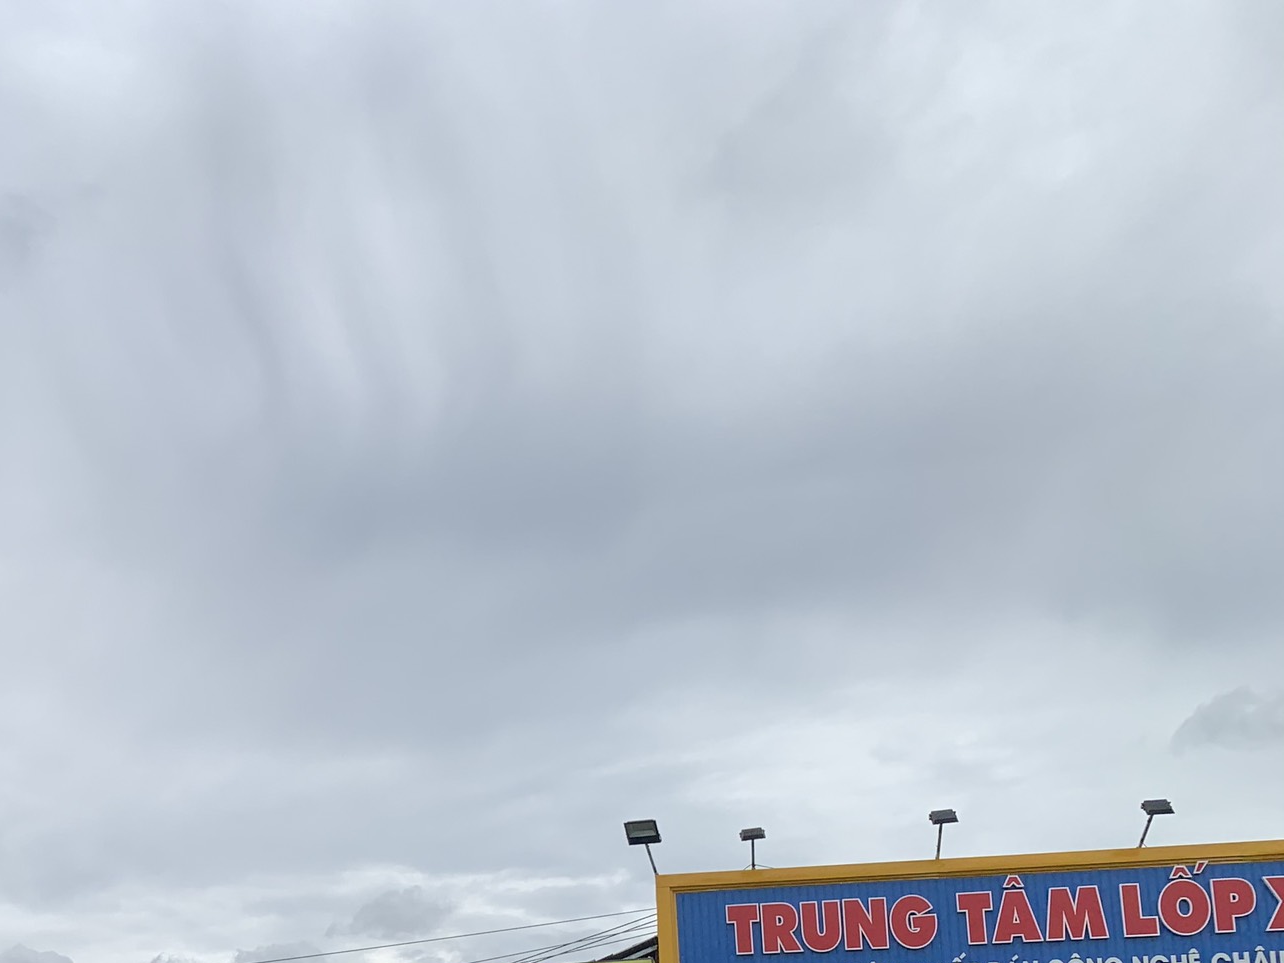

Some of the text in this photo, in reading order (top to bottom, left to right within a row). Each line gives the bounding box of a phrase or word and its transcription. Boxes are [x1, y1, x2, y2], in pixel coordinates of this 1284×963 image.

[725, 894, 938, 956] TRUNG
[955, 874, 1110, 945] TÂM
[1119, 860, 1256, 938] LỐP
